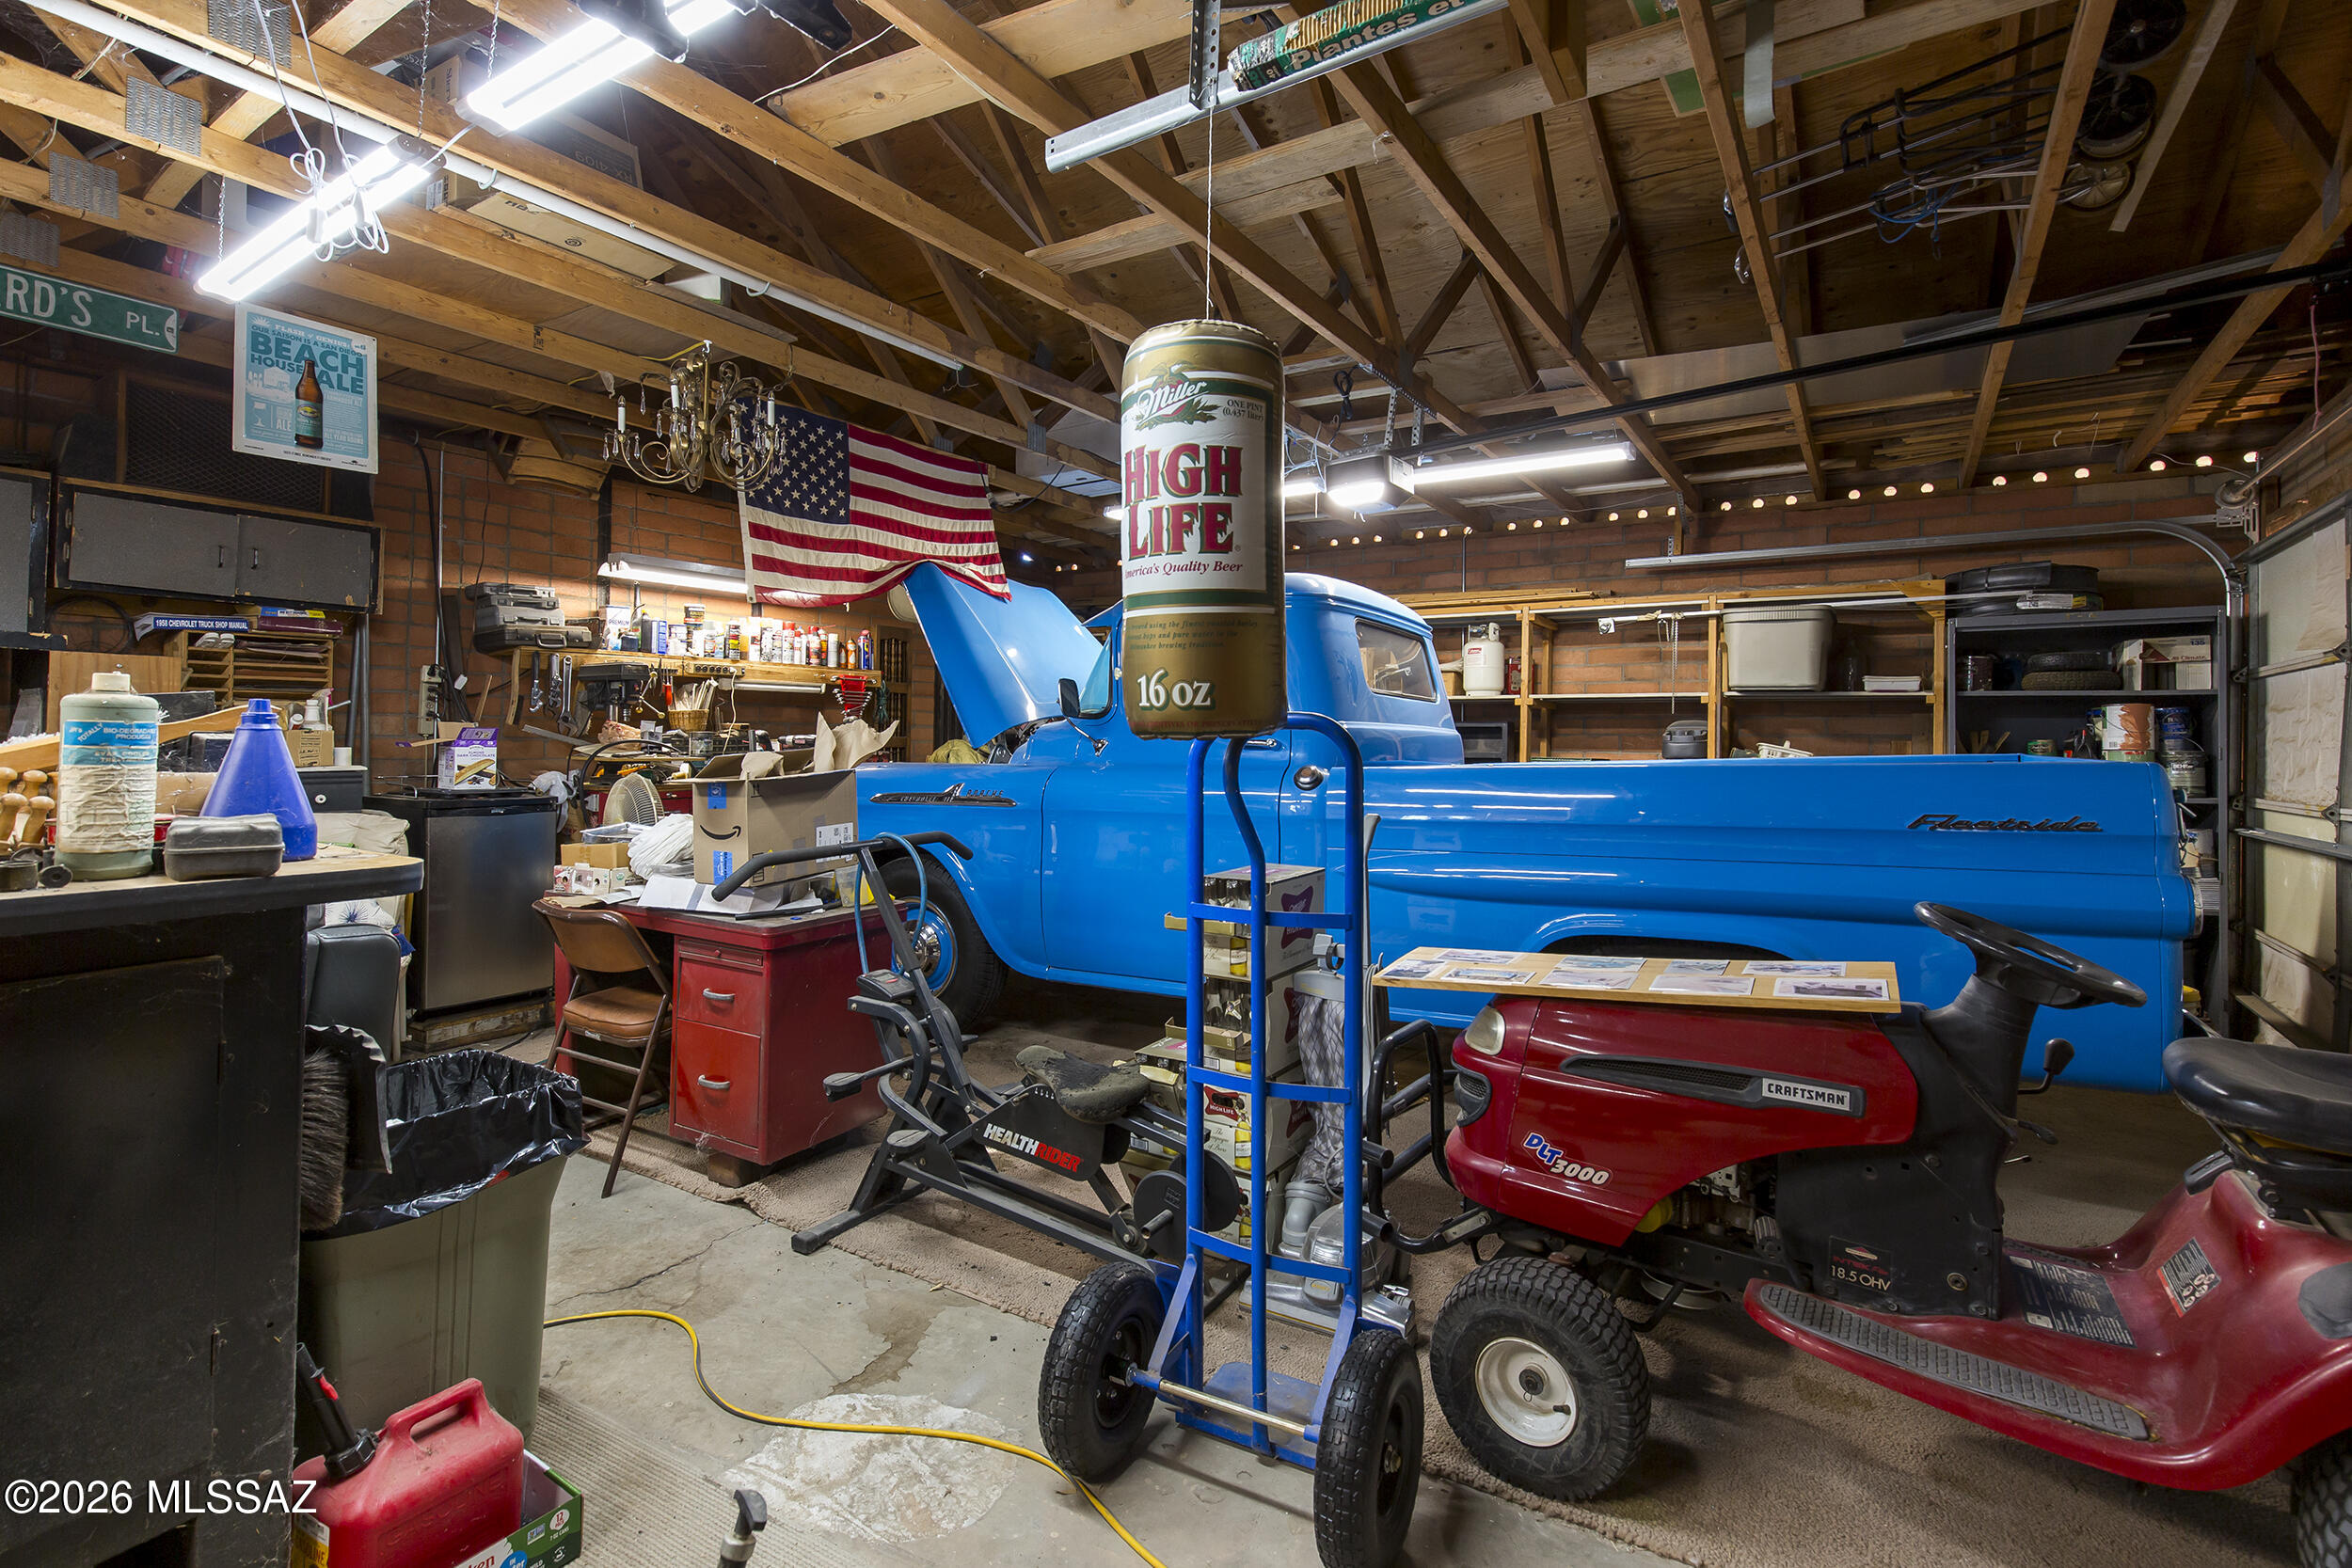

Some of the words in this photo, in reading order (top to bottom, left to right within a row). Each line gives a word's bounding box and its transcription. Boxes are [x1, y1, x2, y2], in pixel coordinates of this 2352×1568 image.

[1291, 10, 1418, 71] Plantes
[0, 273, 93, 326] RD'S
[126, 311, 160, 336] PL.
[251, 325, 270, 335] OUR
[272, 329, 303, 344] SAISON
[312, 340, 319, 348] A
[321, 342, 338, 352] SAN
[339, 346, 364, 357] DIEGO
[250, 331, 364, 378] BEACH
[250, 354, 305, 374] HOUSE
[317, 370, 364, 395] ALE
[1136, 381, 1208, 421] Miller
[1227, 399, 1244, 409] ONE
[1247, 401, 1263, 413] PINT
[276, 418, 293, 432] ALE
[1222, 407, 1247, 419] (0.437
[1248, 410, 1264, 421] liter)
[1124, 443, 1244, 508] HIGH
[1128, 502, 1234, 561] LIFE
[1163, 562, 1210, 576] Quality
[1213, 561, 1244, 572] Beer
[155, 619, 168, 627] 1958
[168, 619, 198, 628] CHEVROLET
[199, 620, 215, 628] TRUCK
[215, 621, 229, 629] SHOP
[229, 621, 248, 630] MANUAL
[1168, 620, 1180, 628] the
[1158, 631, 1170, 640] and
[1172, 632, 1190, 641] pure
[1158, 641, 1187, 650] brewing
[1136, 668, 1168, 709] 16
[1172, 681, 1215, 709] oz
[77, 721, 103, 742] TOTALLY
[1906, 814, 2105, 833] Fleetside
[1767, 1083, 1846, 1106] CRAFTSMAN
[1209, 1103, 1223, 1113] HIGH
[1222, 1106, 1235, 1116] LIFE
[983, 1123, 1083, 1173] HEALTHRIDER
[1524, 1132, 1564, 1165] DLT
[1549, 1157, 1611, 1185] 3000
[1831, 1265, 1857, 1283] 18.5
[1859, 1274, 1891, 1291] OHV
[555, 1512, 564, 1523] 12
